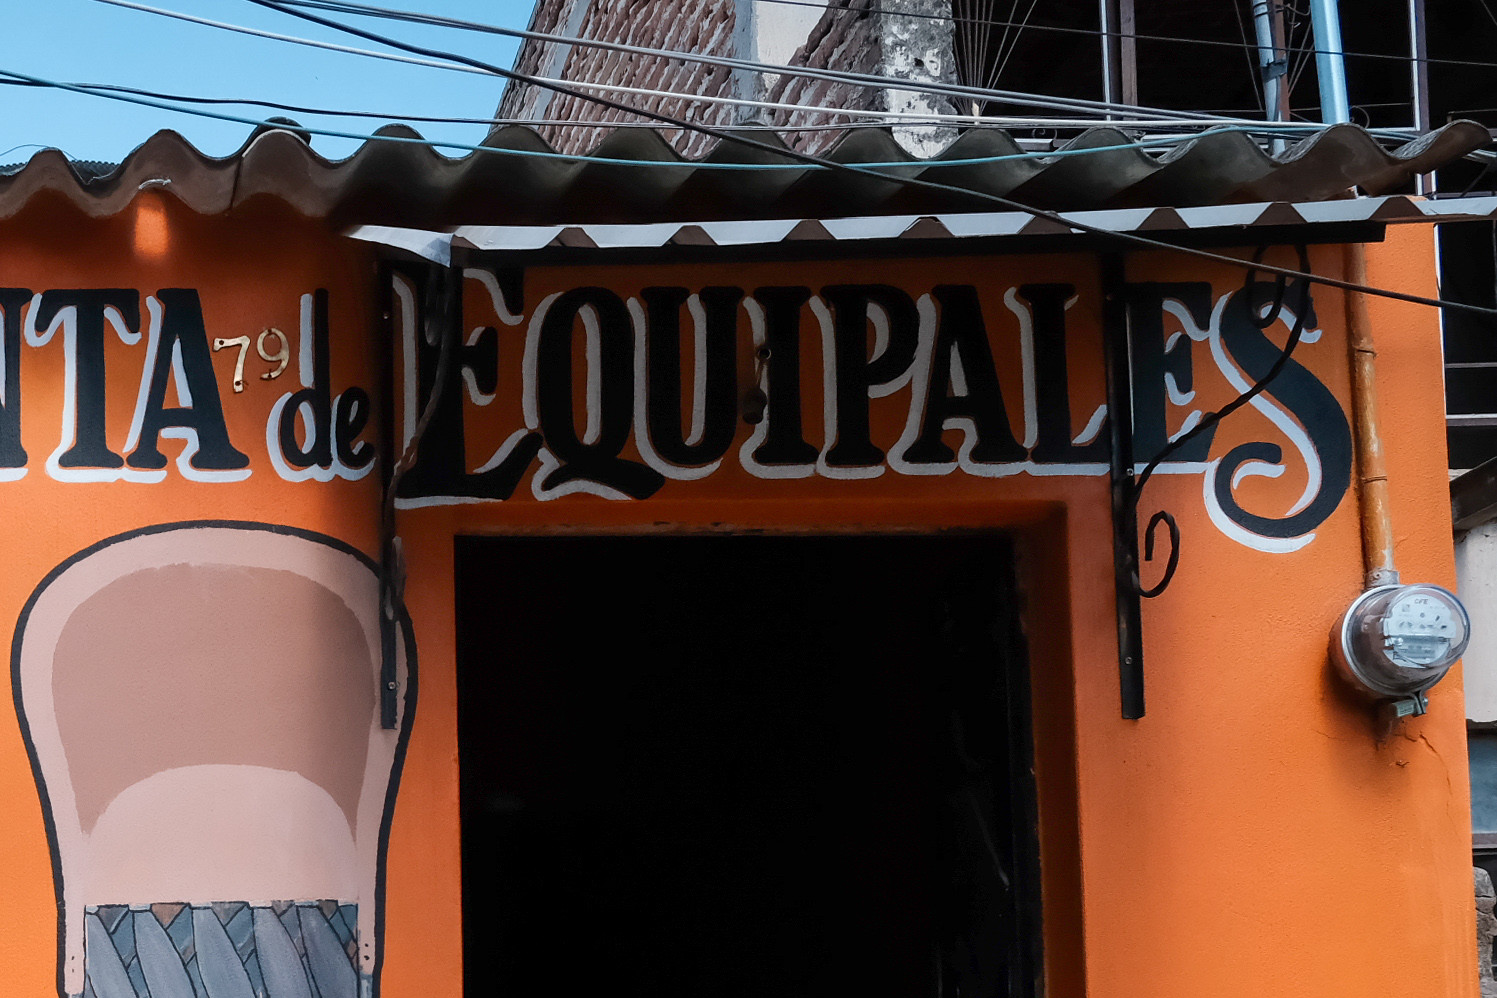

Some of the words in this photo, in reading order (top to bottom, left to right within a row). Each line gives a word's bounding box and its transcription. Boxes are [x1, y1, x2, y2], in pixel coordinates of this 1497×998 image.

[212, 326, 291, 393] 79
[266, 287, 376, 482] de
[392, 262, 1352, 553] EQUIPALES
